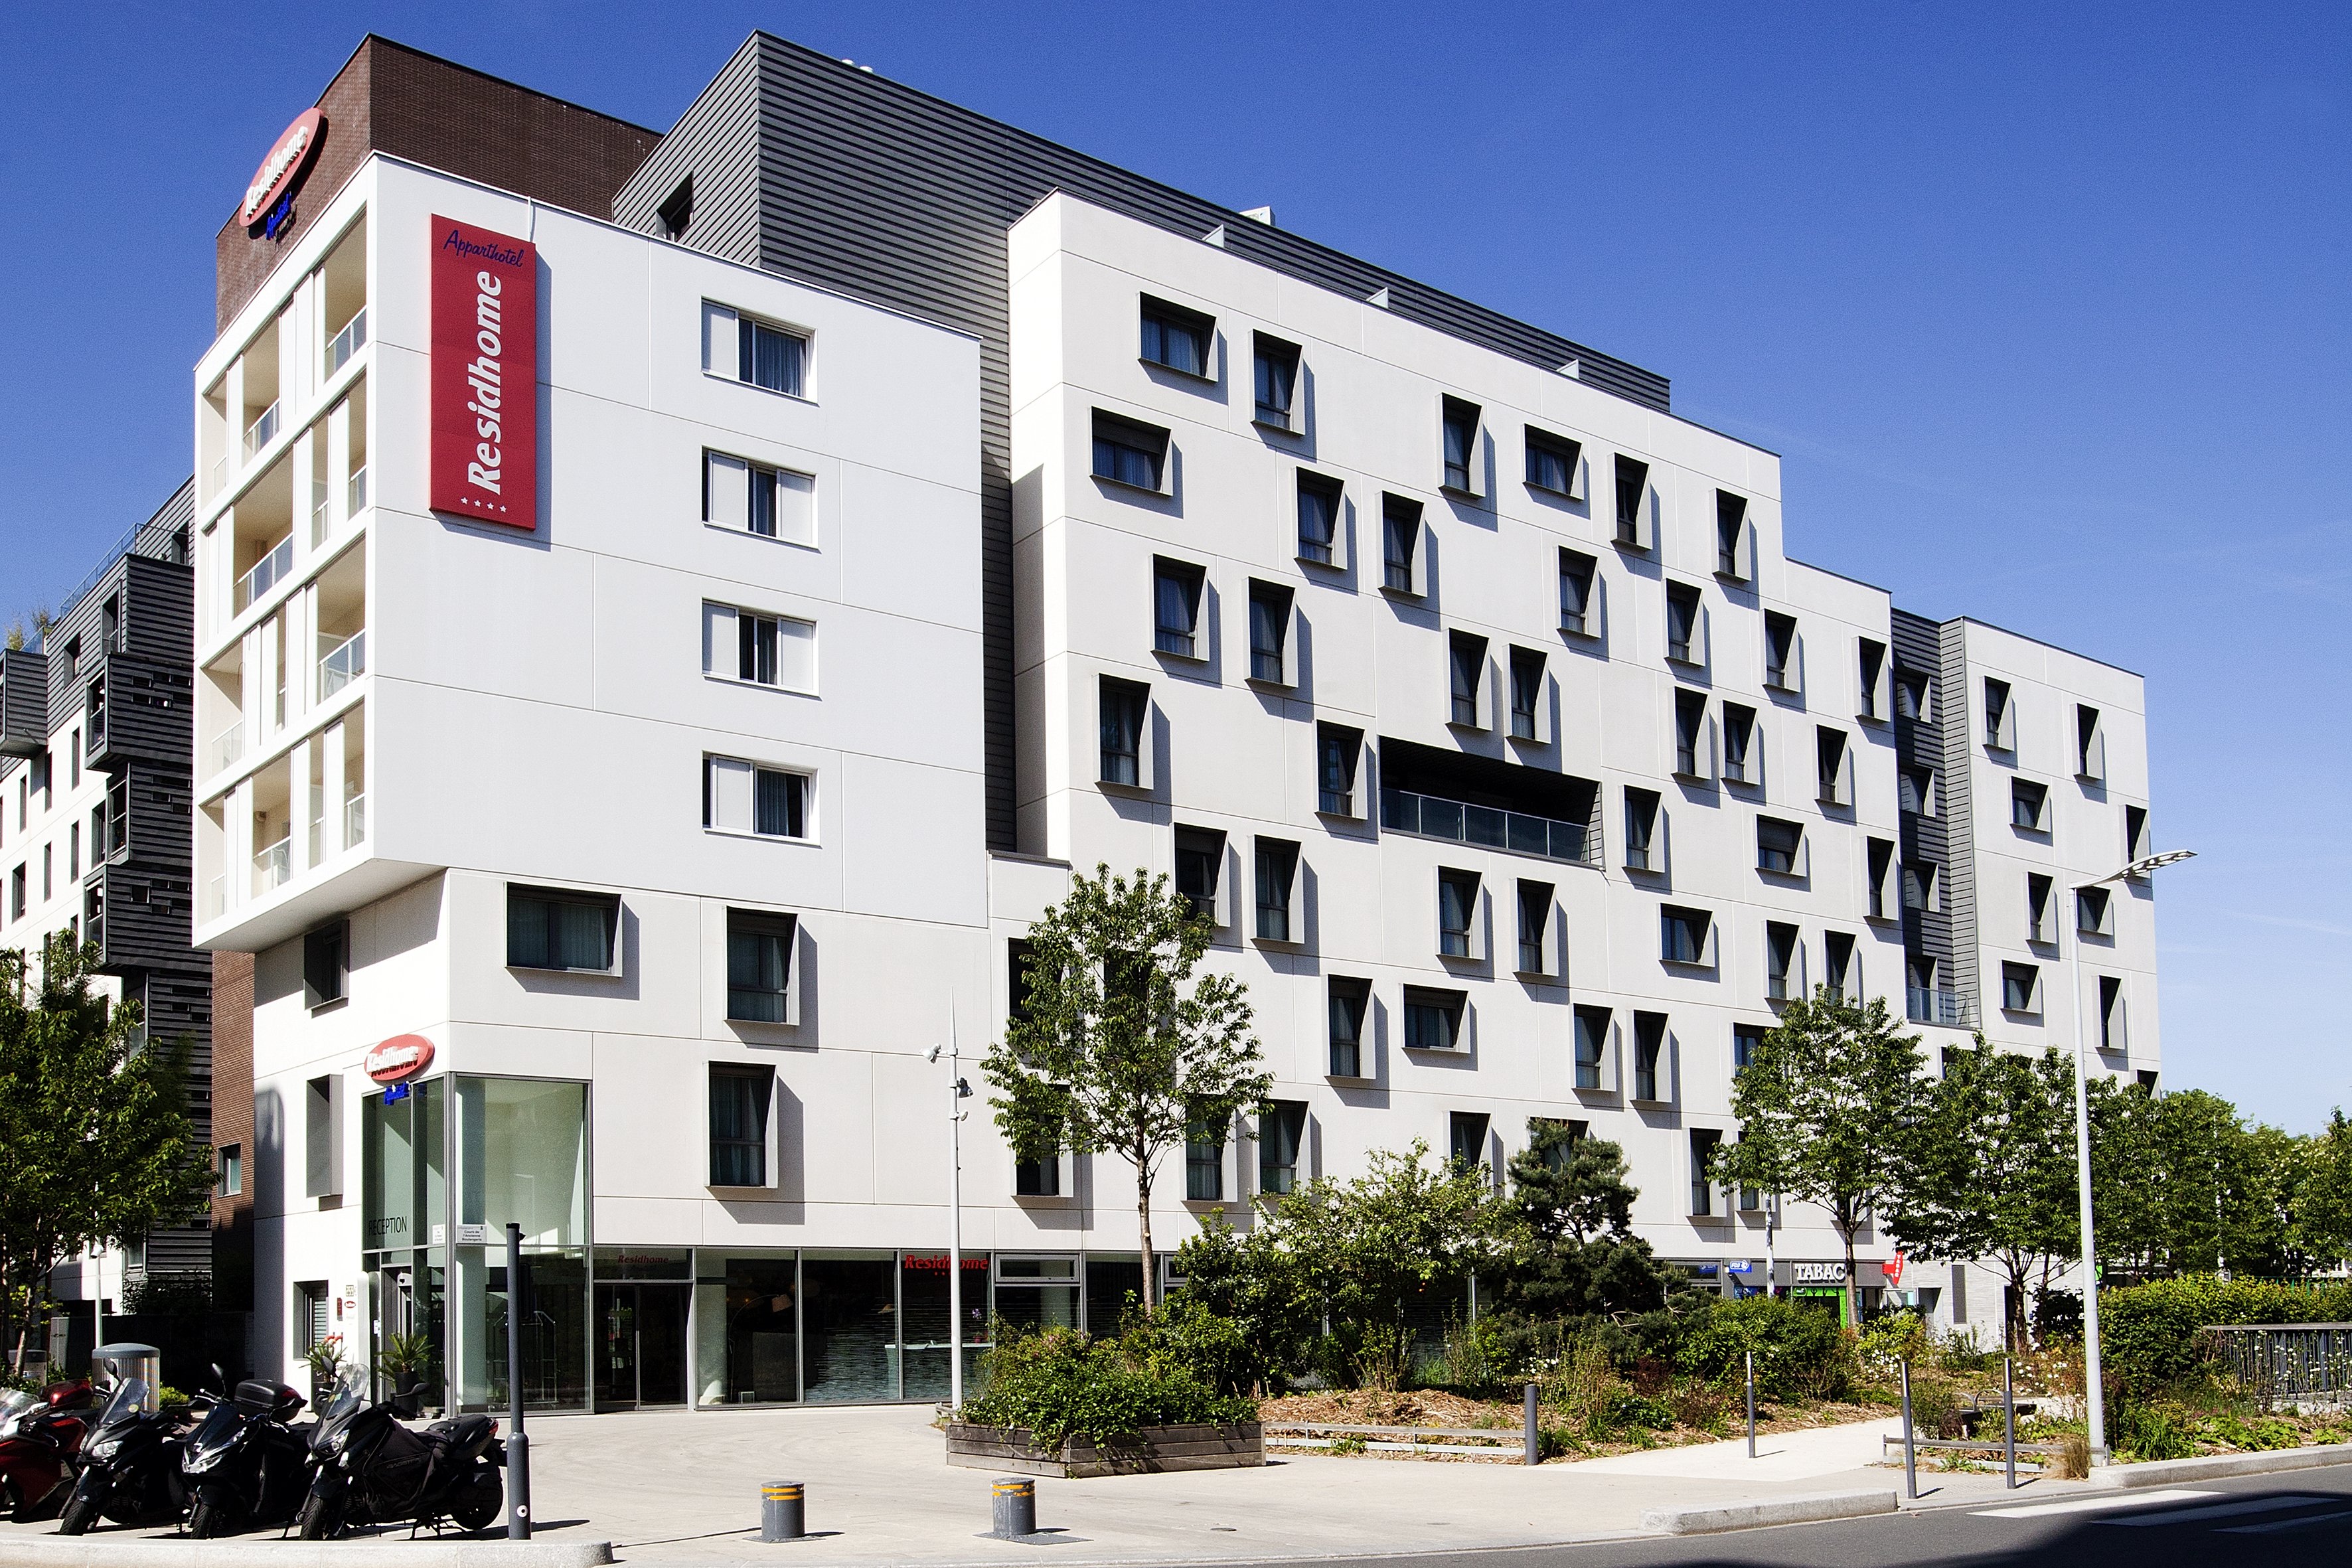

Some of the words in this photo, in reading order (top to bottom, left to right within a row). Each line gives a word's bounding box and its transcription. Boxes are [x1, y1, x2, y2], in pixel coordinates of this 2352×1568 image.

[443, 230, 525, 268] Apparthotel
[467, 271, 502, 496] Residhome
[368, 1216, 407, 1235] RECEPTION
[618, 1255, 669, 1263] Residhome
[1794, 1263, 1846, 1281] TABAC
